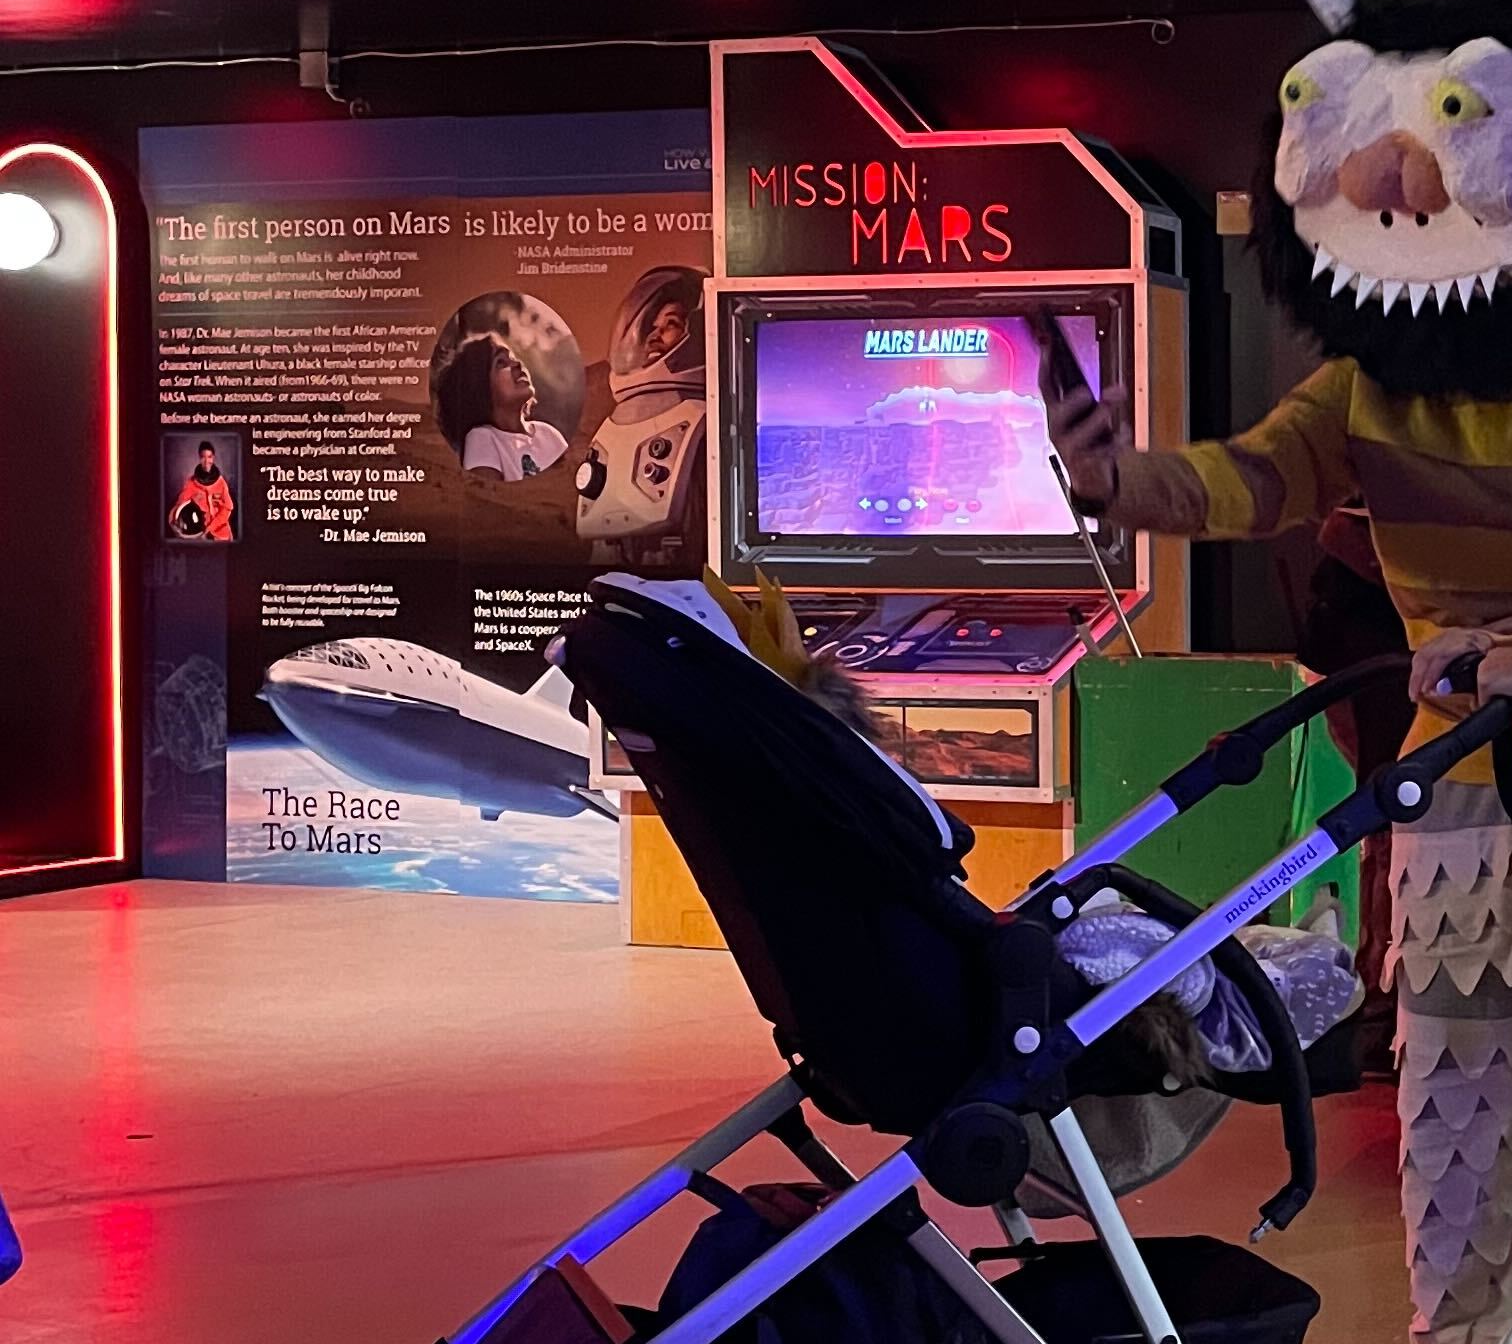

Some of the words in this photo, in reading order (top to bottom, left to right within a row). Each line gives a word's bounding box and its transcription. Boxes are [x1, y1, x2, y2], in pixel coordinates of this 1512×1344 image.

[750, 161, 927, 208] MISSION:
[212, 215, 258, 240] first
[265, 217, 344, 244] person
[352, 218, 382, 236] on
[389, 211, 450, 236] Mars
[464, 210, 486, 236] is
[492, 209, 560, 240] likely
[567, 212, 590, 234] to
[597, 208, 626, 233] be
[633, 213, 647, 233] a
[852, 204, 1012, 265] MARS
[553, 244, 634, 258] Administrator
[160, 255, 177, 267] The
[179, 254, 199, 266] first
[240, 254, 251, 264] to
[254, 252, 277, 263] walk
[280, 254, 294, 263] on
[297, 252, 322, 263] Mars
[325, 252, 333, 262] is
[337, 251, 362, 262] alive
[365, 251, 391, 264] right
[517, 262, 539, 275] Jim
[542, 262, 608, 274] Bridenstine
[184, 272, 202, 284] like
[204, 273, 233, 286] many
[235, 271, 263, 282] other
[325, 269, 343, 281] her
[346, 268, 401, 281] childhood
[159, 290, 196, 302] dreams
[198, 290, 209, 301] of
[211, 291, 241, 304] space
[244, 288, 273, 300] travel
[275, 290, 291, 300] are
[293, 286, 367, 301] tremendously
[196, 327, 209, 338] Dr.
[212, 327, 231, 338] Mae
[274, 327, 313, 337] became
[314, 326, 330, 336] the
[332, 326, 351, 336] first
[352, 325, 387, 336] African
[388, 325, 436, 335] American
[865, 329, 916, 354] MARS
[918, 328, 989, 353] LANDER
[159, 344, 190, 355] female
[240, 344, 252, 354] At
[253, 345, 270, 356] age
[293, 343, 309, 353] she
[312, 344, 330, 353] was
[332, 342, 371, 354] inspired
[373, 342, 386, 354] by
[388, 341, 404, 352] the
[406, 341, 419, 351] TV
[159, 360, 202, 371] character
[204, 360, 254, 370] Lieutenant
[288, 361, 294, 369] a
[296, 358, 321, 369] black
[323, 358, 357, 369] female
[358, 357, 397, 370] starship
[399, 357, 430, 368] officer
[160, 377, 172, 386] on
[173, 376, 192, 386] Star
[215, 375, 242, 386] When
[244, 375, 251, 385] it
[253, 375, 277, 386] aired
[351, 374, 377, 385] there
[379, 376, 403, 385] were
[405, 376, 419, 385] no
[160, 392, 186, 402] NASA
[278, 393, 289, 401] or
[291, 391, 341, 401] astronauts
[343, 390, 353, 401] of
[160, 413, 190, 424] Before
[192, 413, 209, 423] she
[210, 413, 247, 423] became
[249, 414, 261, 423] an
[313, 412, 330, 423] she
[367, 412, 385, 422] her
[386, 412, 421, 425] degree
[263, 429, 321, 441] engineering
[323, 428, 347, 438] from
[348, 428, 390, 439] Stanford
[392, 427, 411, 438] and
[252, 444, 291, 455] became
[292, 447, 299, 455] a
[300, 444, 345, 457] physician
[347, 445, 357, 454] at
[298, 466, 329, 482] best
[332, 469, 362, 485] way
[365, 468, 380, 482] to
[383, 466, 425, 482] make
[267, 485, 321, 501] dreams
[324, 488, 364, 501] come
[368, 487, 398, 501] true
[267, 504, 281, 520] is
[284, 506, 298, 520] to
[301, 505, 340, 520] wake
[343, 529, 370, 542] Mae
[372, 529, 426, 542] Jemison
[474, 589, 493, 601] The
[496, 590, 524, 602] 1960s
[526, 590, 555, 603] Space
[557, 591, 581, 602] Race
[474, 606, 491, 617] the
[493, 606, 526, 618] United
[528, 607, 558, 618] States
[560, 607, 580, 618] and
[474, 622, 498, 634] Mars
[500, 623, 508, 634] is
[510, 625, 516, 634] a
[474, 639, 494, 650] and
[262, 787, 318, 817] The
[328, 790, 400, 820] Race
[262, 823, 296, 851] To
[306, 825, 381, 854] Mars
[1224, 843, 1318, 924] mockingbird
